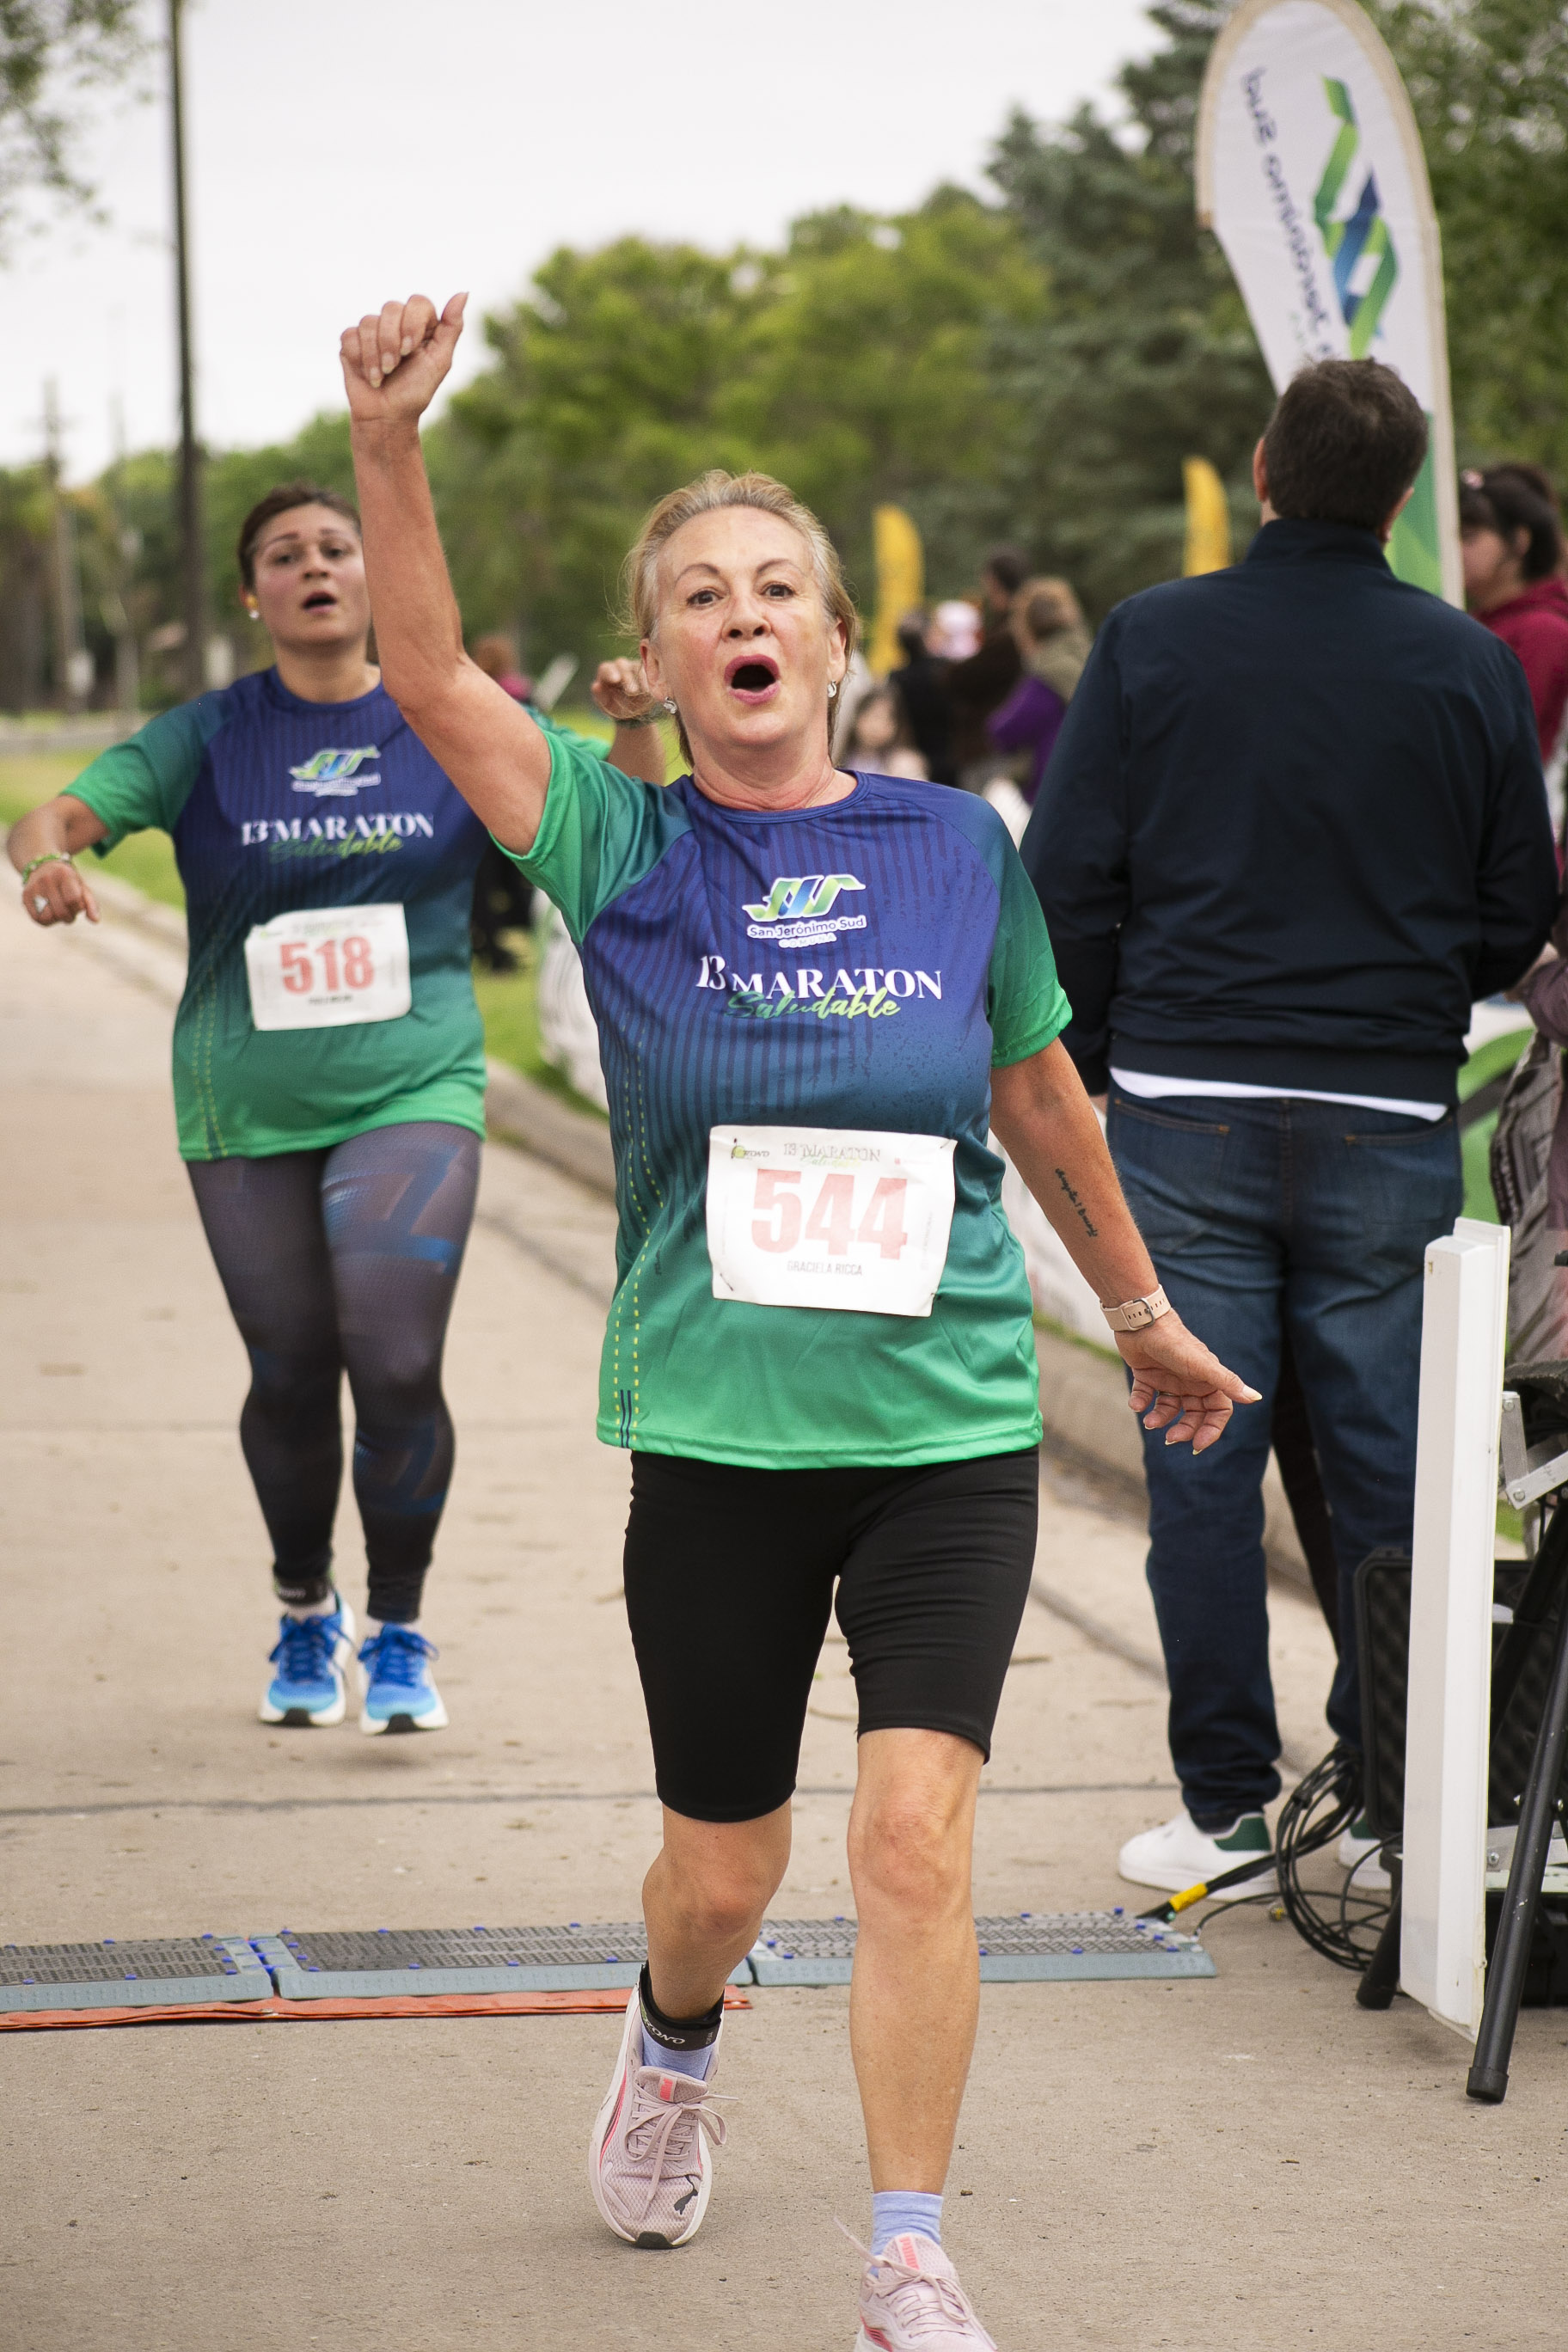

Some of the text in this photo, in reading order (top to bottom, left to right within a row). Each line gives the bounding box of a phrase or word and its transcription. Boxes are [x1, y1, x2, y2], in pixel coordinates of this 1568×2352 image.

[242, 812, 434, 846] 13 MARATON
[750, 916, 864, 938] San Jerónimo Sud
[780, 934, 836, 947] COMUNA
[279, 935, 375, 995] 518
[695, 954, 942, 1000] 13 MARATON
[726, 986, 901, 1020] Saludable
[801, 1144, 881, 1162] MARATON
[751, 1168, 908, 1260] 544
[787, 1260, 863, 1276] GRACIELA RICCA
